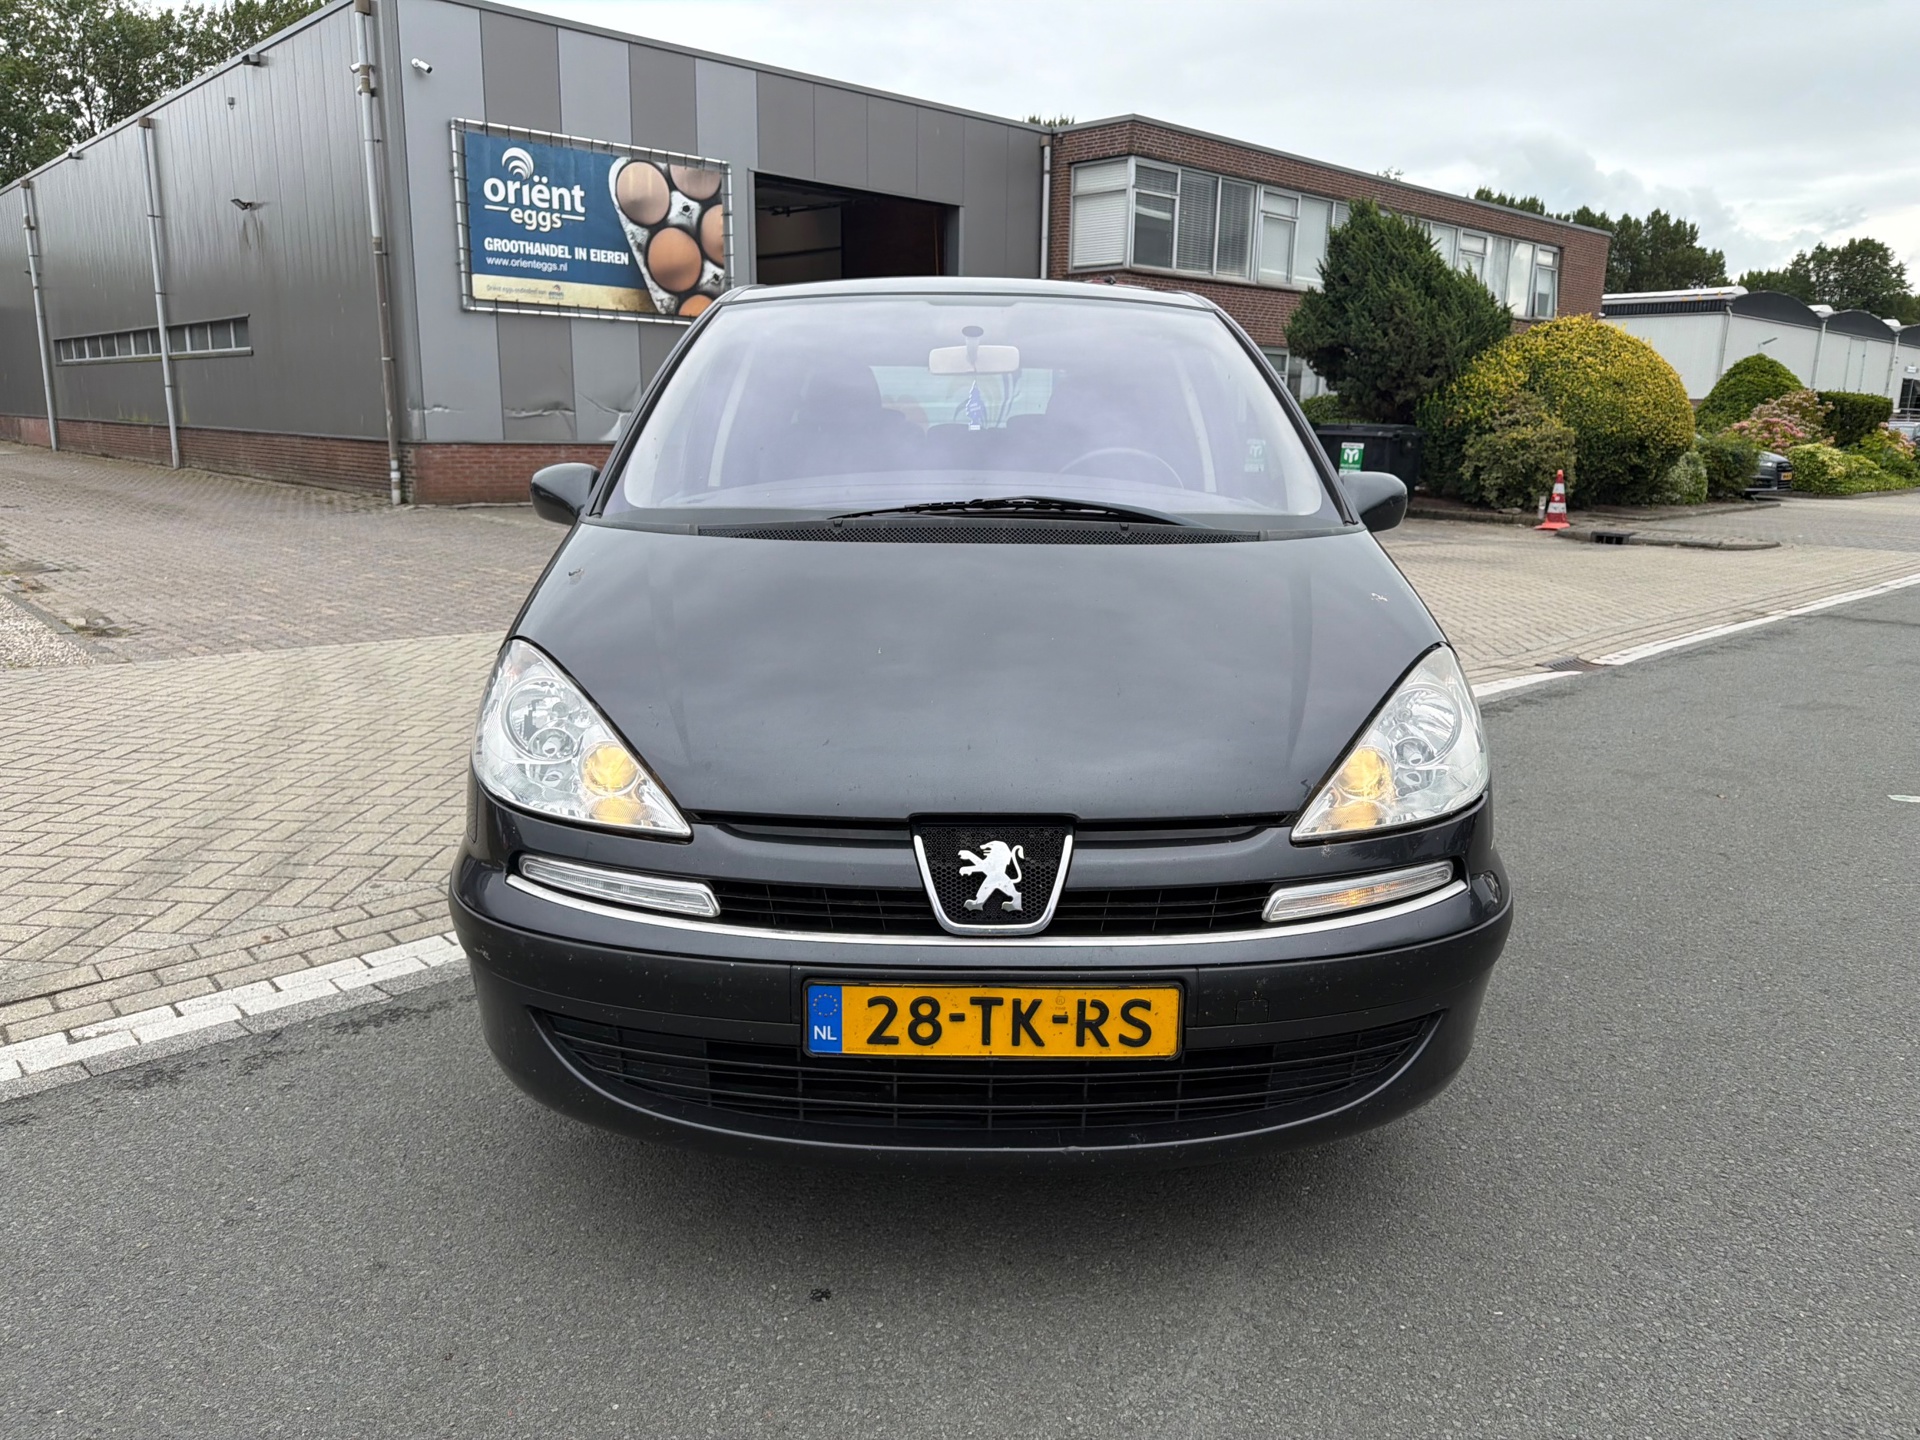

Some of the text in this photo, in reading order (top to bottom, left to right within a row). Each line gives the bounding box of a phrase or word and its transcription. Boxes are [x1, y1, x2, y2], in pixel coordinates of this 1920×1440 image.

[483, 175, 585, 213] oriënt
[510, 208, 562, 232] eggs
[484, 237, 629, 265] GROOTHANDEL IN EIEREN
[486, 256, 568, 272] www.orienteggs.nl
[813, 1024, 838, 1041] NL
[866, 995, 1153, 1048] 28-TK-RS
